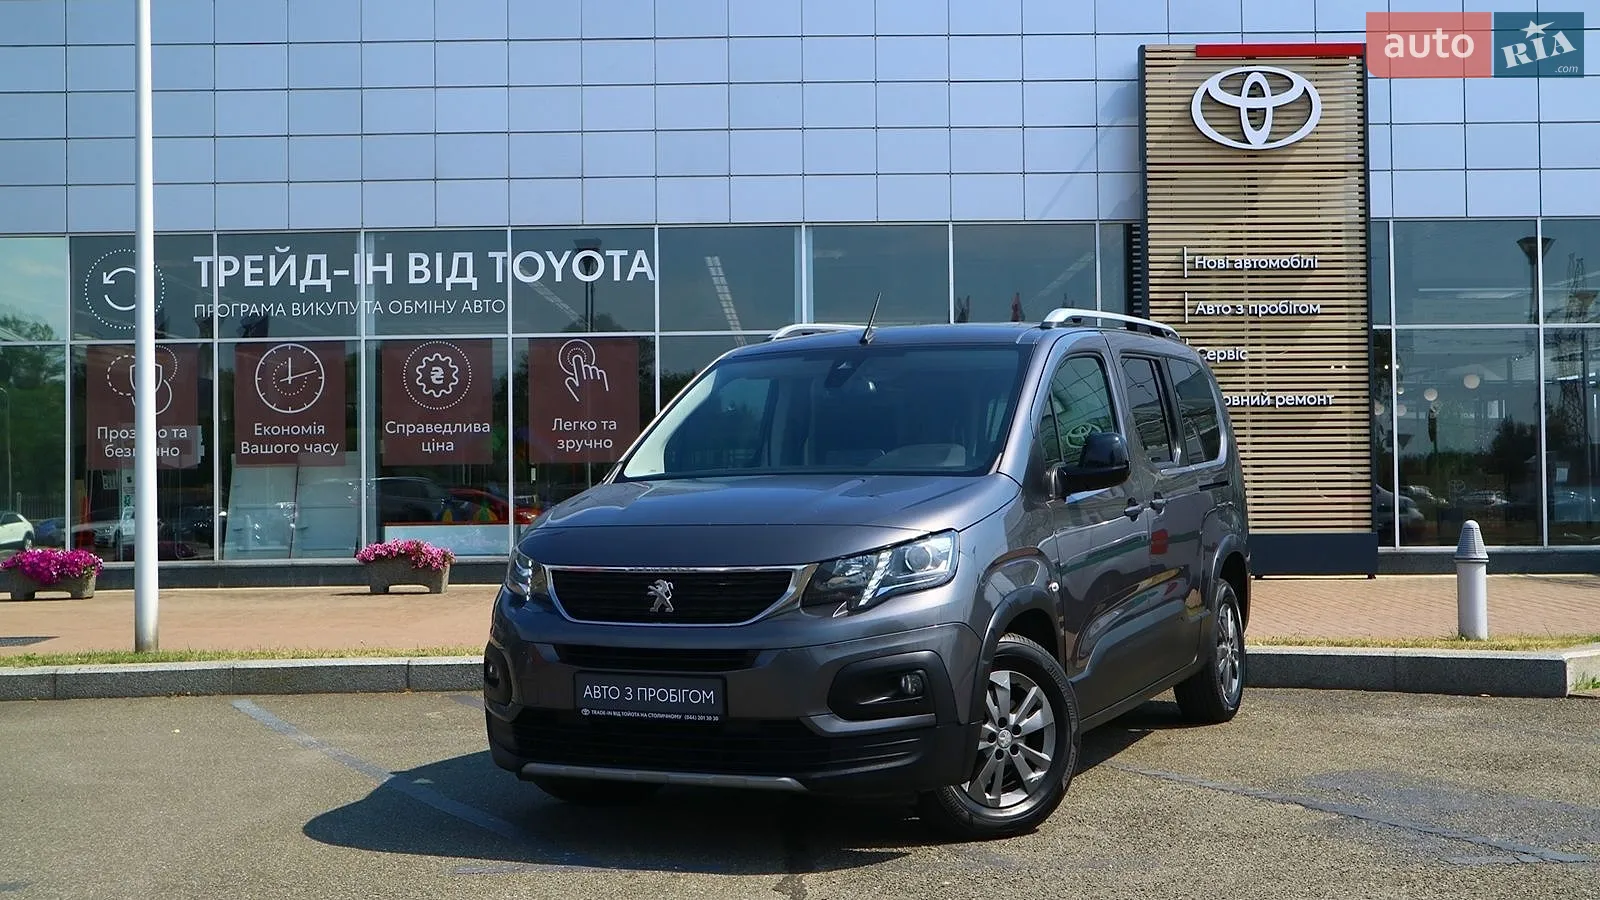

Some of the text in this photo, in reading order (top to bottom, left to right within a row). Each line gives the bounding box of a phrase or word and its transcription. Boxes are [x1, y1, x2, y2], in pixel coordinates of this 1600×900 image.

[193, 245, 655, 293] ТРЕЙД-ІН ВІД TOYOTA
[1194, 255, 1319, 269] Нові автомобілі
[194, 299, 506, 318] ПРОГРАМА ВИКУПУ ТА ОБМІНУ АВТО
[1194, 301, 1321, 317] Авто з пробігом
[1222, 392, 1335, 408] овний ремонт
[254, 421, 325, 436] Економія
[385, 420, 491, 434] Справедлива
[552, 418, 617, 431] Легко та
[97, 426, 188, 442] Прозо та
[241, 441, 339, 456] Вашого часу
[421, 437, 455, 453] ціна
[557, 438, 613, 451] зручно
[583, 685, 715, 704] АВТО З ПРОБІГОМ
